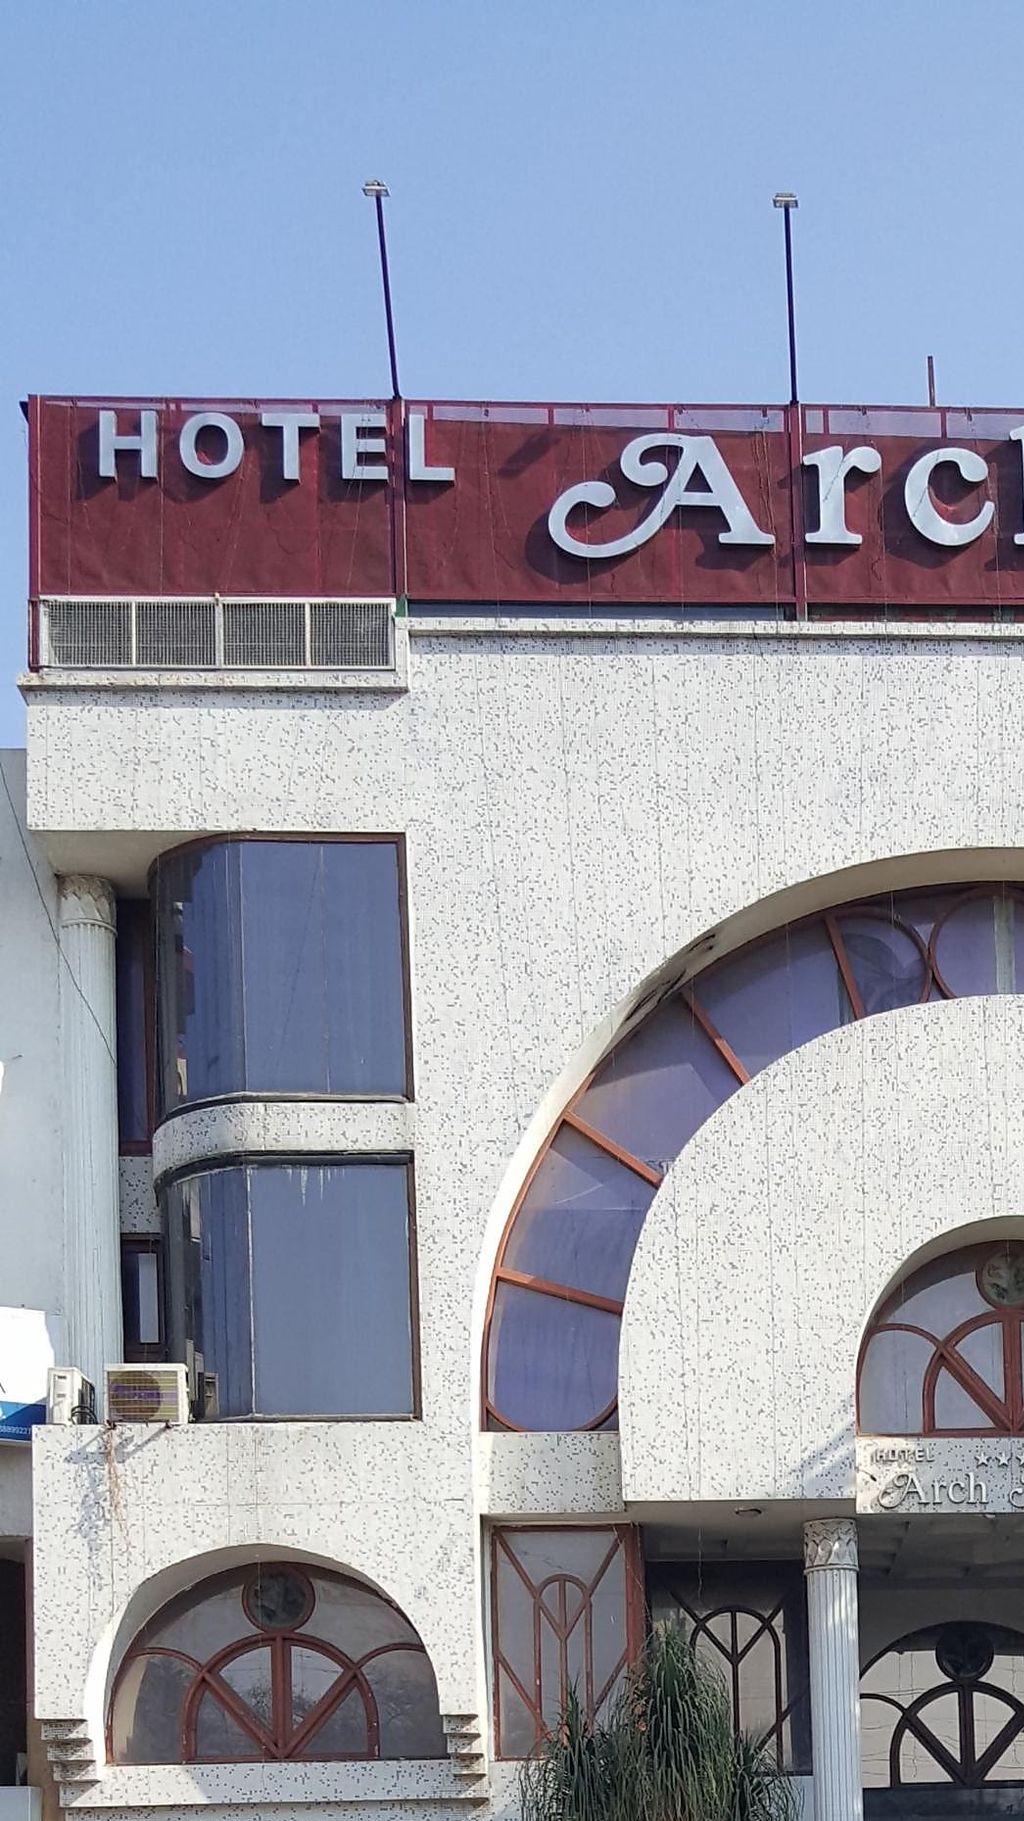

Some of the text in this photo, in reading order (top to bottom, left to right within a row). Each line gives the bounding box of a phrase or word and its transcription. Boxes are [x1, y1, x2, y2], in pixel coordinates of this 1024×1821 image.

[98, 410, 456, 482] HOTEL
[872, 1447, 935, 1463] HOTEL
[878, 1471, 988, 1509] Arch
